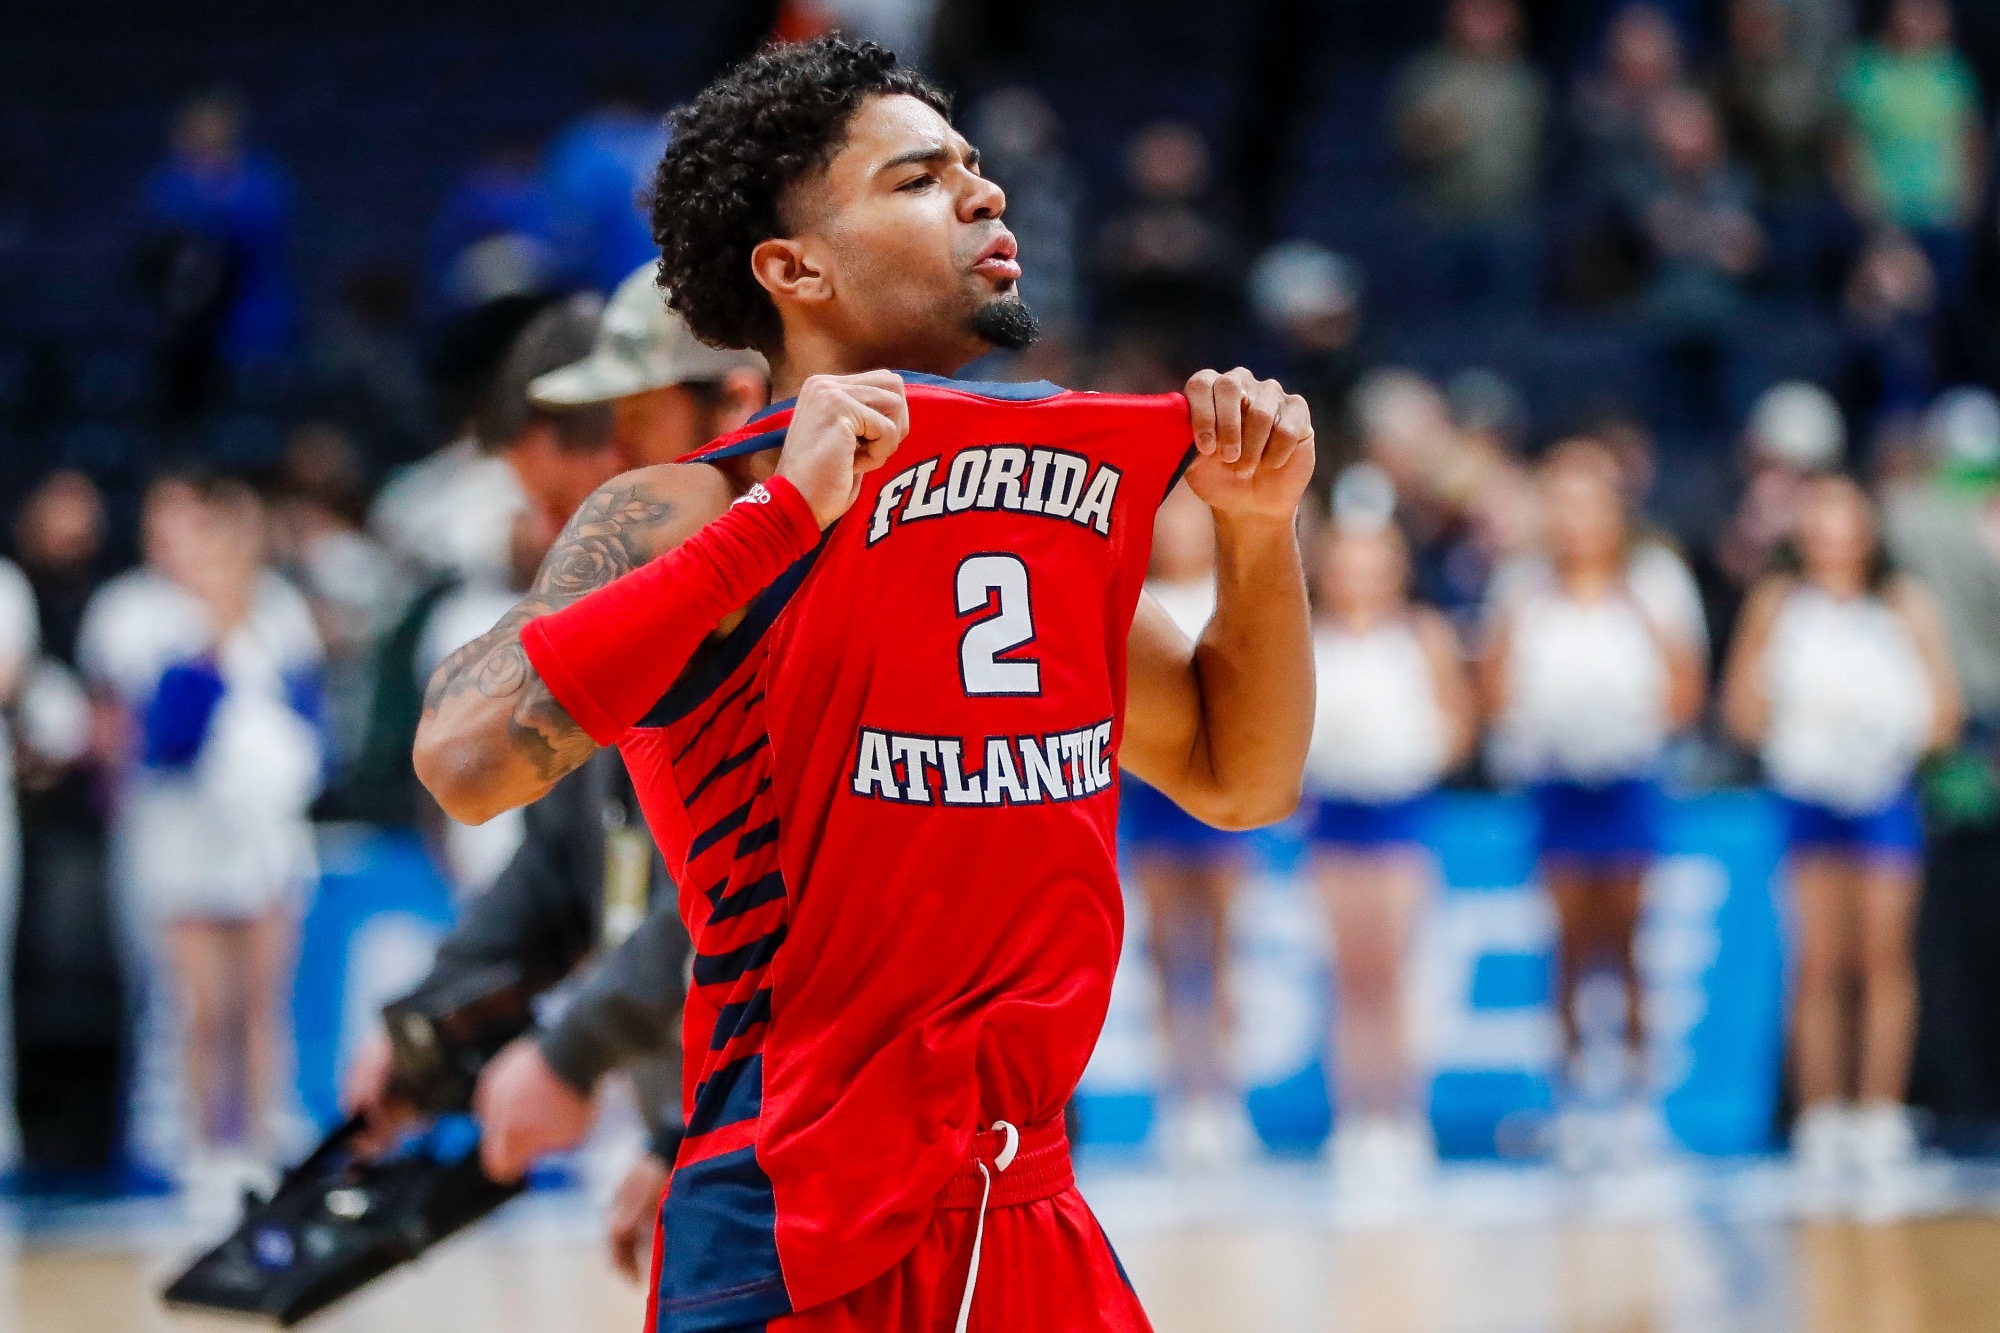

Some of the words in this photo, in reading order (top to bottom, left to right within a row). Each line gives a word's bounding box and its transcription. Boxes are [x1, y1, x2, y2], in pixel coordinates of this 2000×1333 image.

[866, 444, 1123, 549] FLORIDA
[954, 551, 1042, 697] 2
[850, 717, 1115, 806] ATLANTIC
